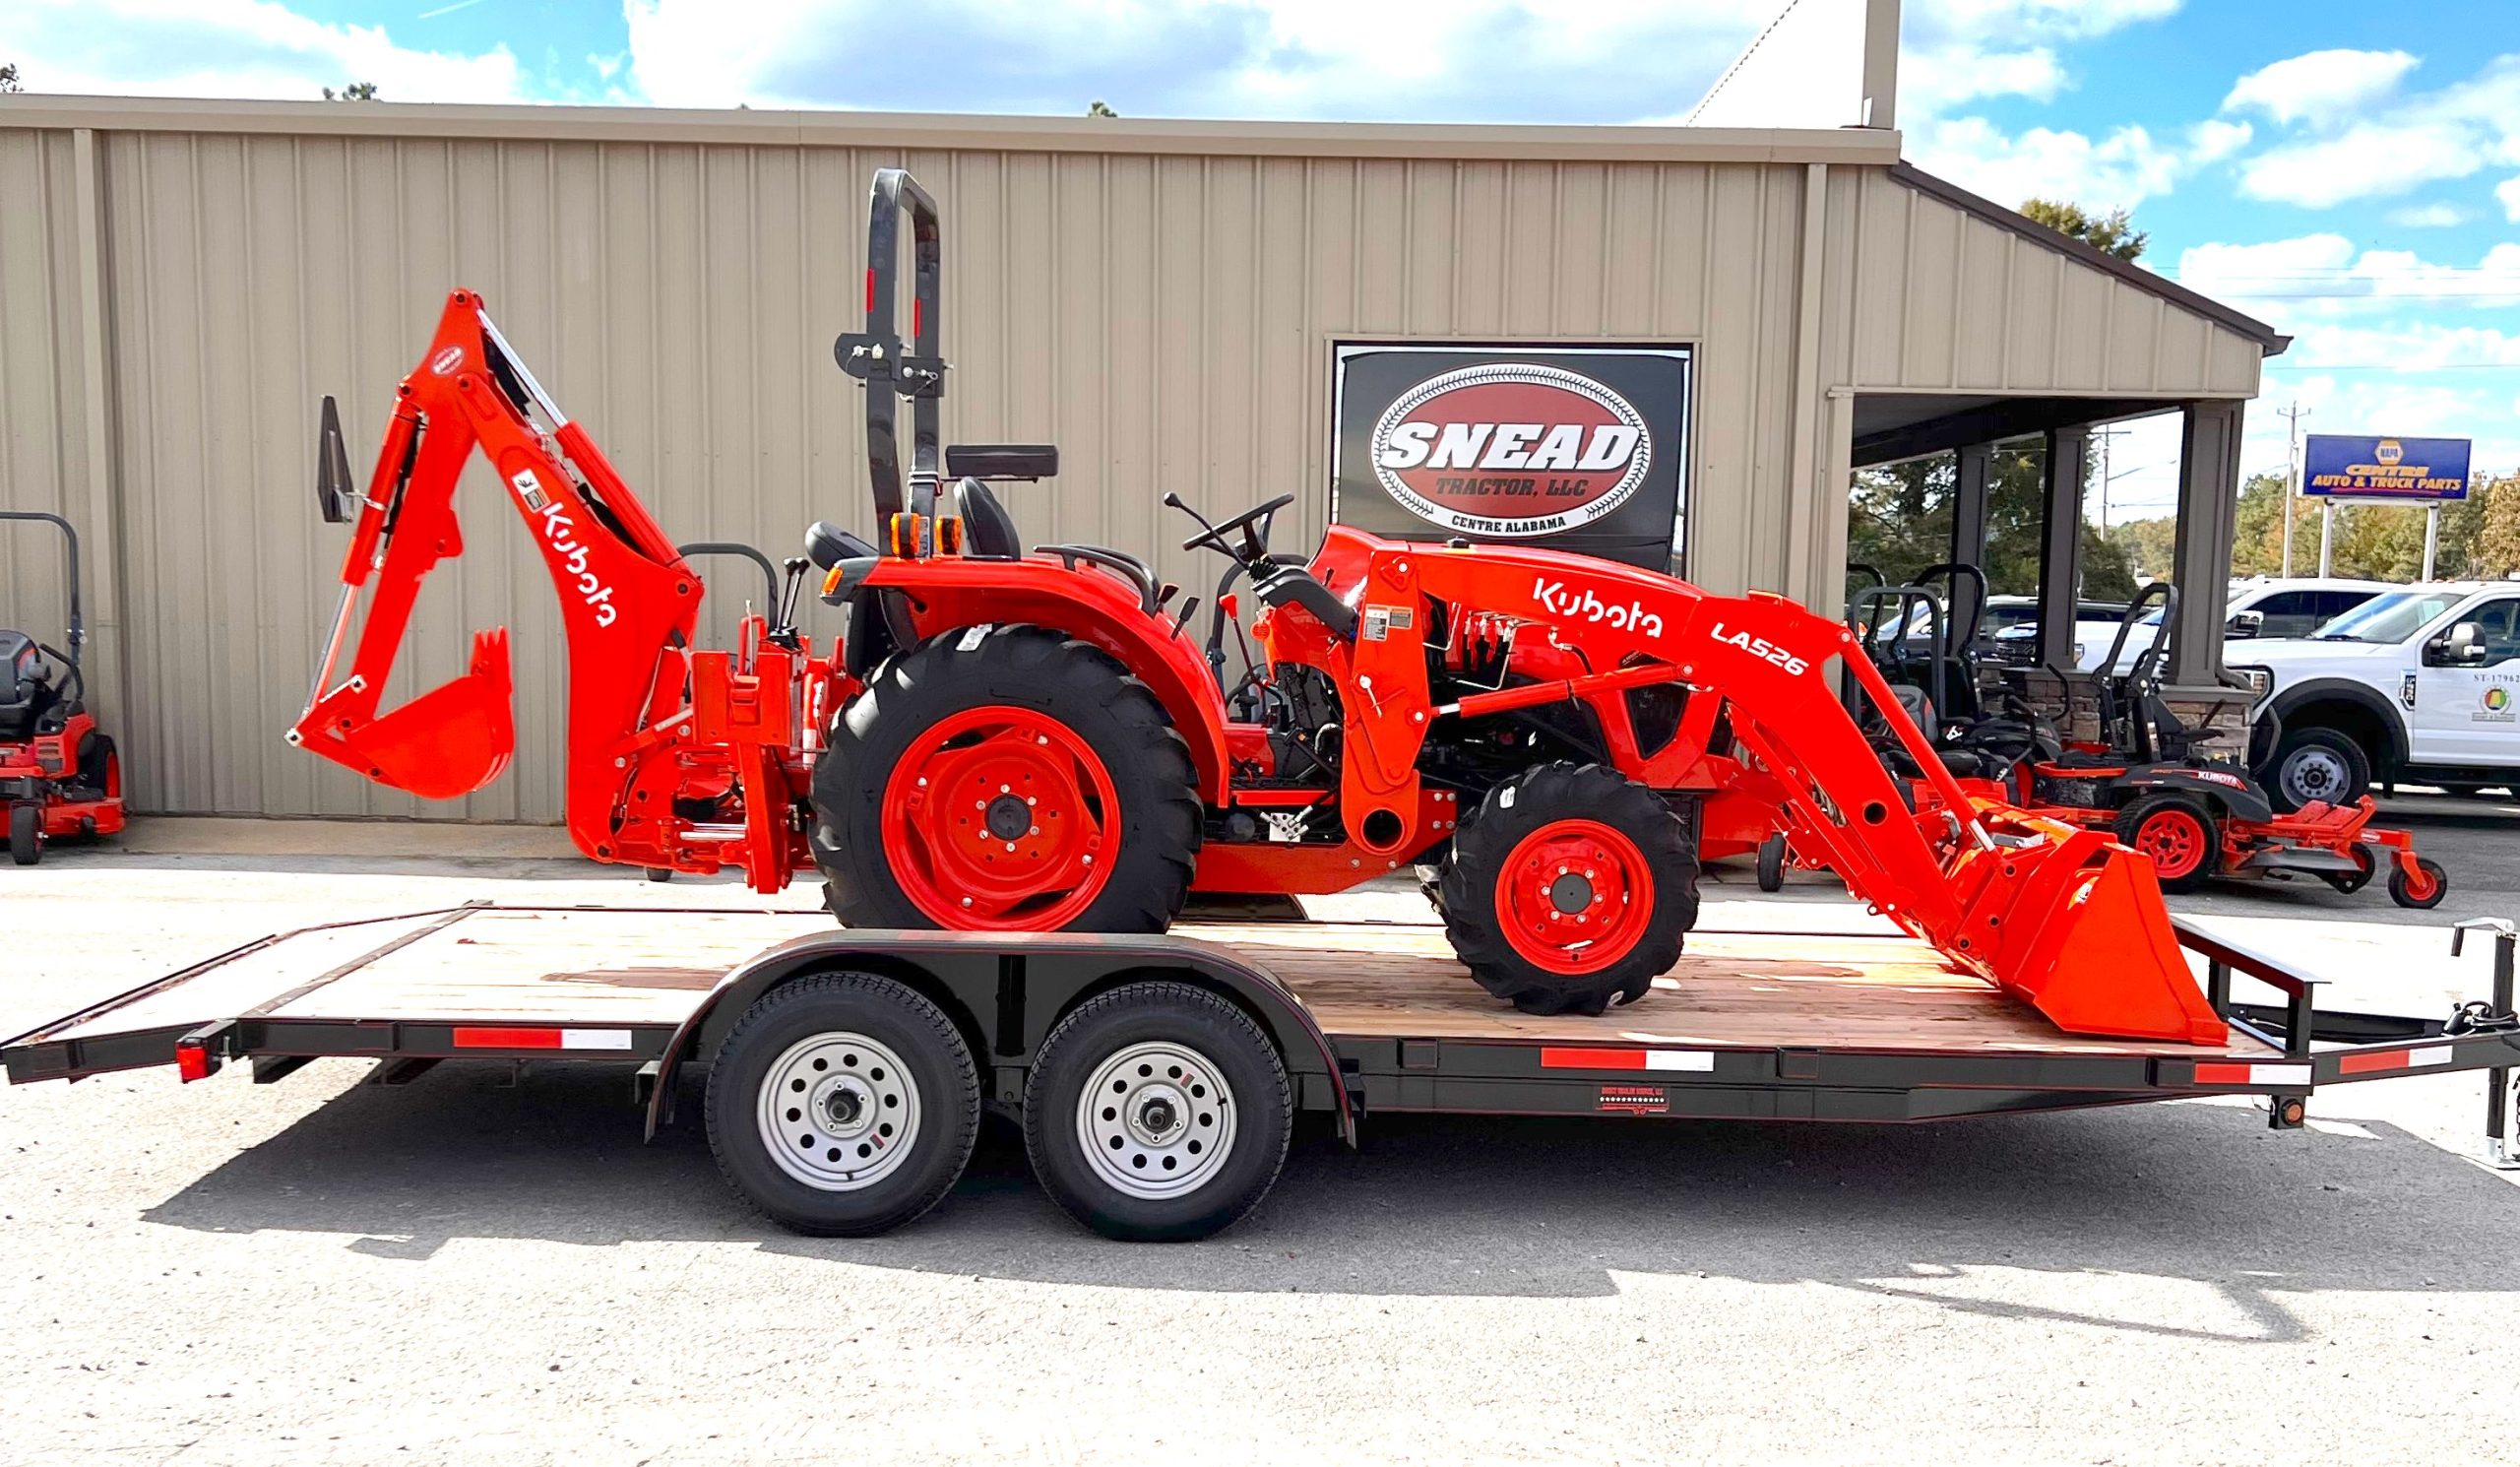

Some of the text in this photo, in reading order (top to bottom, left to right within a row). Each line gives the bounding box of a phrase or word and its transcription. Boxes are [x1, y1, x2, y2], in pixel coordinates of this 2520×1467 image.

[1378, 421, 1641, 471] SNEAD
[1436, 478, 1589, 497] TRACTOR, LLC
[2312, 475, 2462, 490] AUTO & TRUCK PARTS
[1452, 514, 1566, 533] CENTRE ALABAMA
[542, 502, 617, 628] Kubota
[1533, 578, 1664, 638] Kubota
[1710, 622, 1809, 676] LA526
[2197, 771, 2237, 787] KUBOTA
